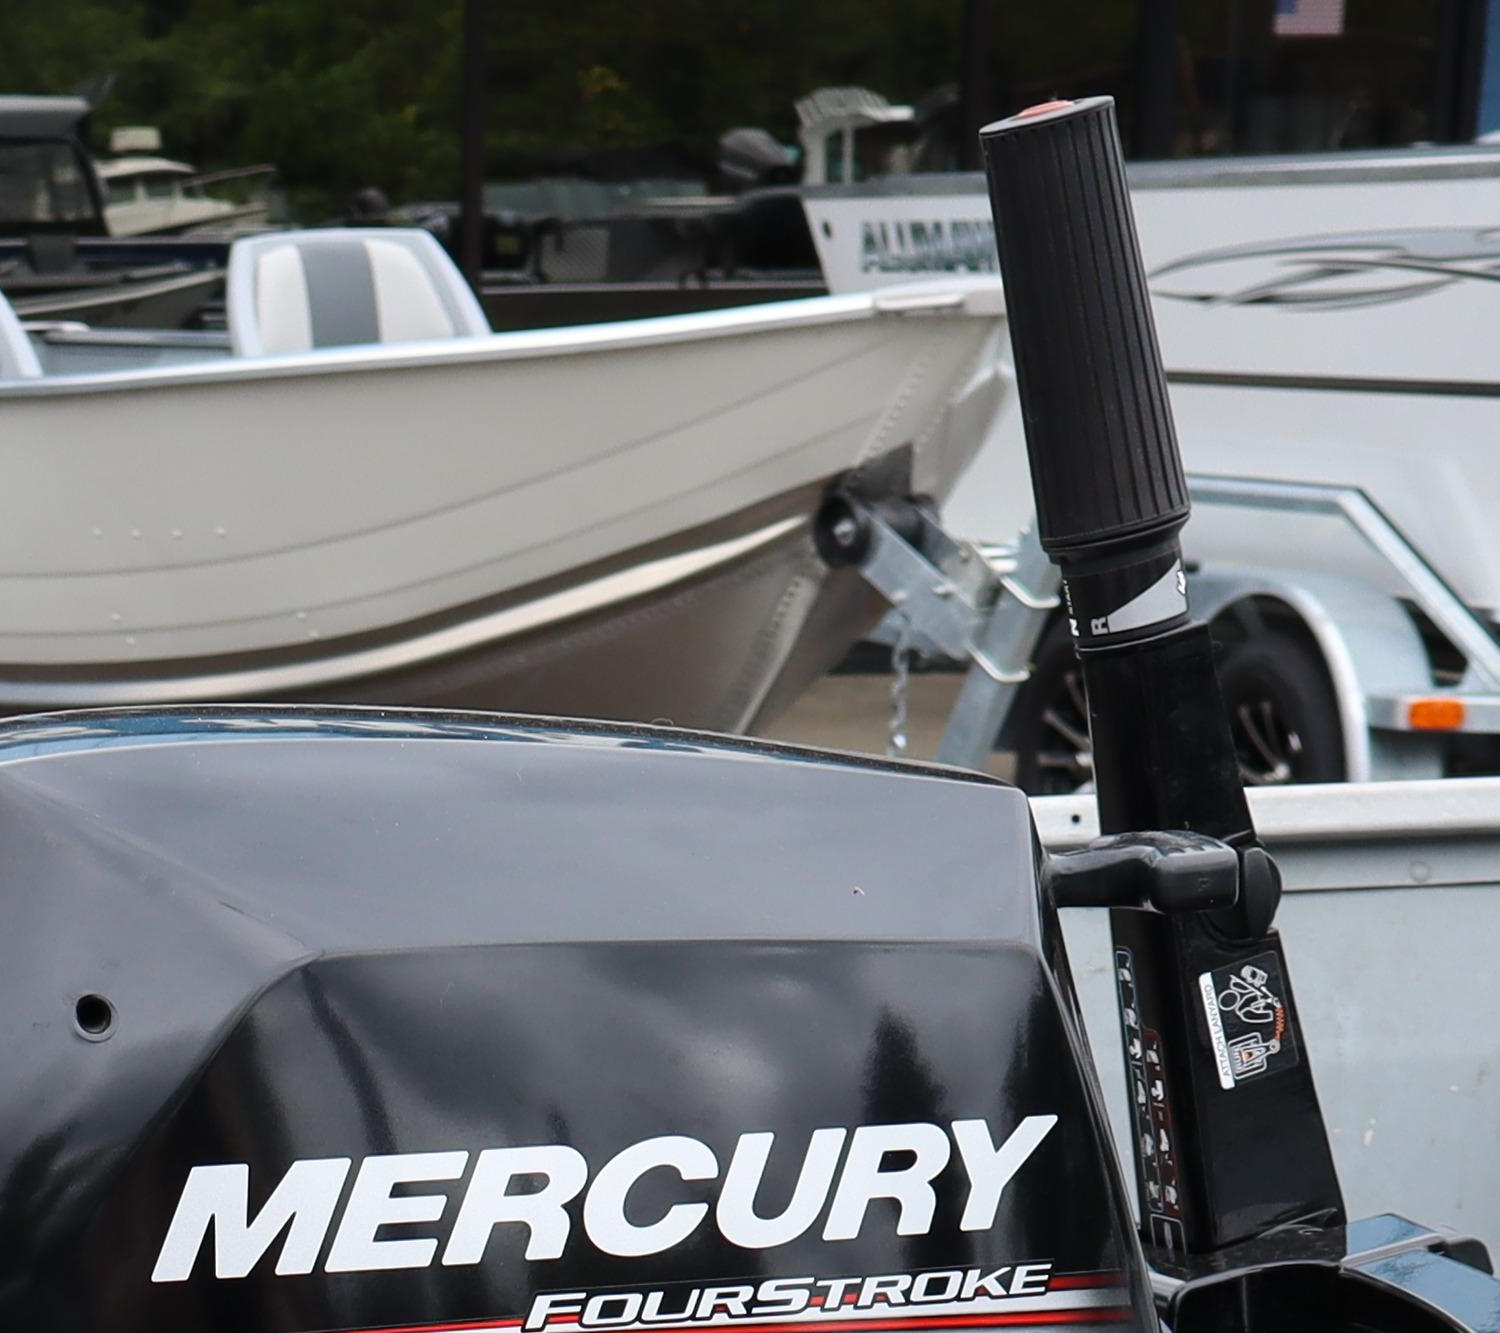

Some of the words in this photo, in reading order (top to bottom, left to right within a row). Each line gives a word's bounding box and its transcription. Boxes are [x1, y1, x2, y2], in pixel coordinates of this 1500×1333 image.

[1091, 616, 1108, 635] R
[151, 1115, 1058, 1282] MERCURY
[523, 1262, 1054, 1332] FOURSTROKE
